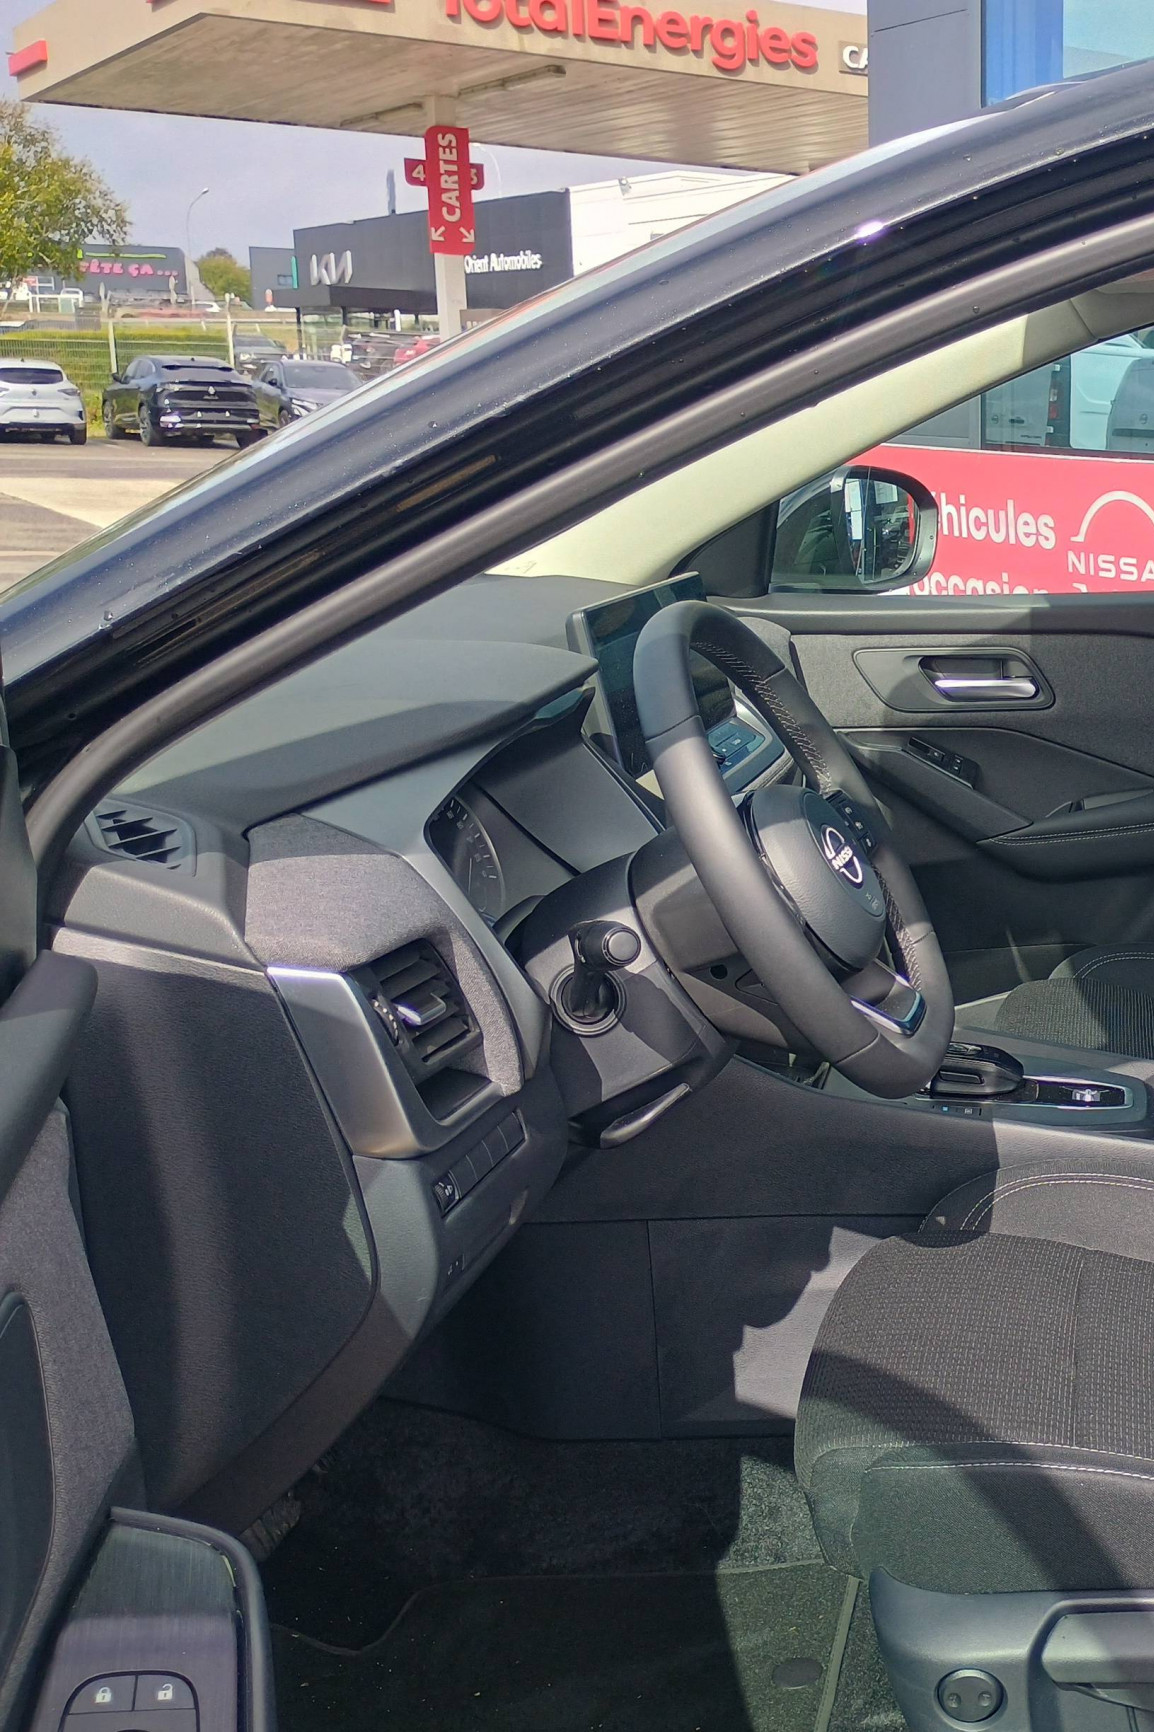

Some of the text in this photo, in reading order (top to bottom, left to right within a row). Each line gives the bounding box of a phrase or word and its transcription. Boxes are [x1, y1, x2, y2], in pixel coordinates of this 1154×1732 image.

[412, 164, 426, 181] 4
[437, 133, 461, 222] CARTES
[464, 250, 543, 274] Orient Automobiles
[931, 491, 1057, 550] hicules
